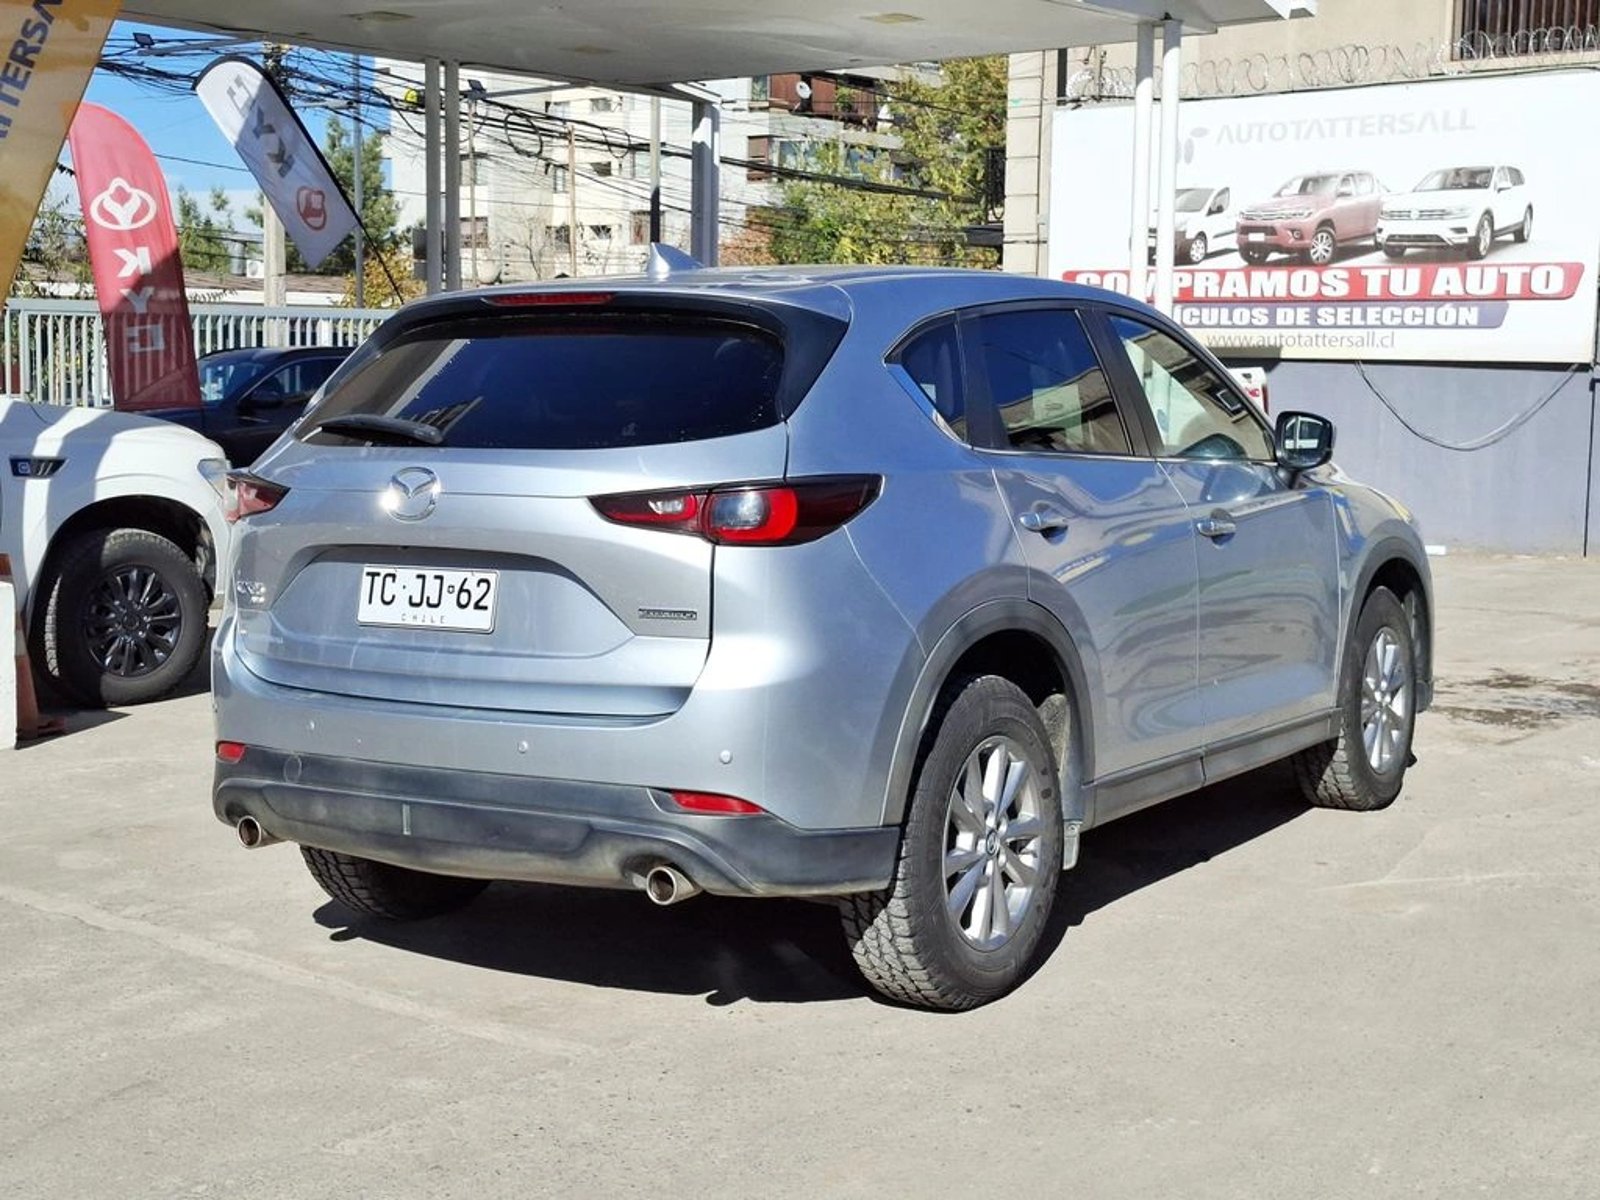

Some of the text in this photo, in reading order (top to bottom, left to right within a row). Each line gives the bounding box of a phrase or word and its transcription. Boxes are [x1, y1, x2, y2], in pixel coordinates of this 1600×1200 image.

[1216, 108, 1477, 145] AUTOTATTERSALL
[1076, 264, 1565, 298] OPRAMOS TU AUTO
[1172, 303, 1479, 327] ÍCULOS DE SELECCIÓN
[1206, 331, 1396, 349] www.autotattersall.cl
[401, 613, 446, 625] CHILE
